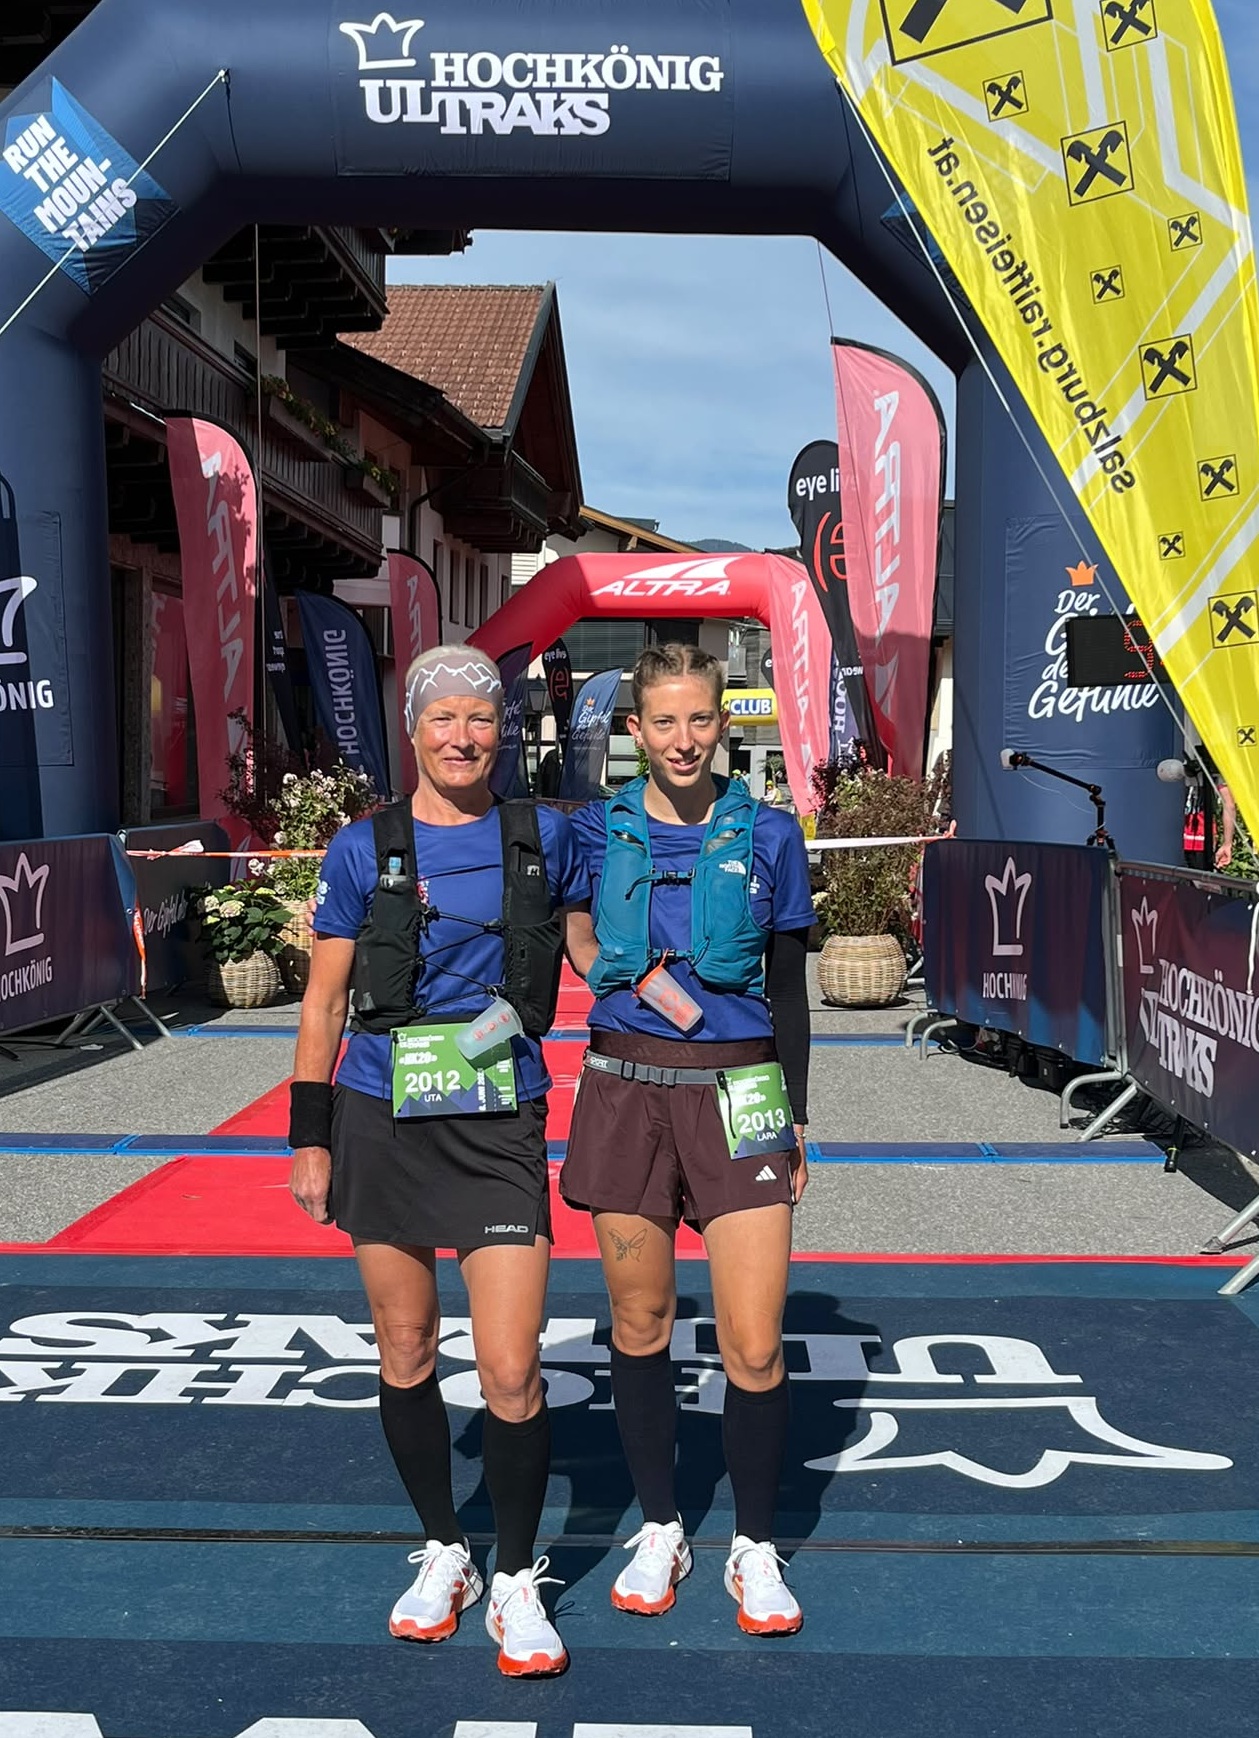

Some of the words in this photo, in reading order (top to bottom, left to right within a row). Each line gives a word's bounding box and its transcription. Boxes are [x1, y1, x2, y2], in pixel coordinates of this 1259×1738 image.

[430, 45, 724, 92] HOCHKÖNIG
[359, 79, 610, 135] ULTRAKS
[2, 114, 56, 174] RUN
[23, 136, 79, 193] THE
[33, 156, 112, 234] MOUN-
[61, 178, 137, 252] TAINS
[589, 579, 731, 597] ALTRA
[1054, 590, 1100, 614] Der
[730, 699, 772, 715] CLUB
[0, 956, 53, 1002] OCHKÖNIG
[404, 1069, 461, 1094] 2012
[424, 1093, 443, 1103] UTA
[737, 1107, 786, 1134] 2013
[756, 1131, 778, 1142] LARA
[484, 1224, 529, 1234] HEAD
